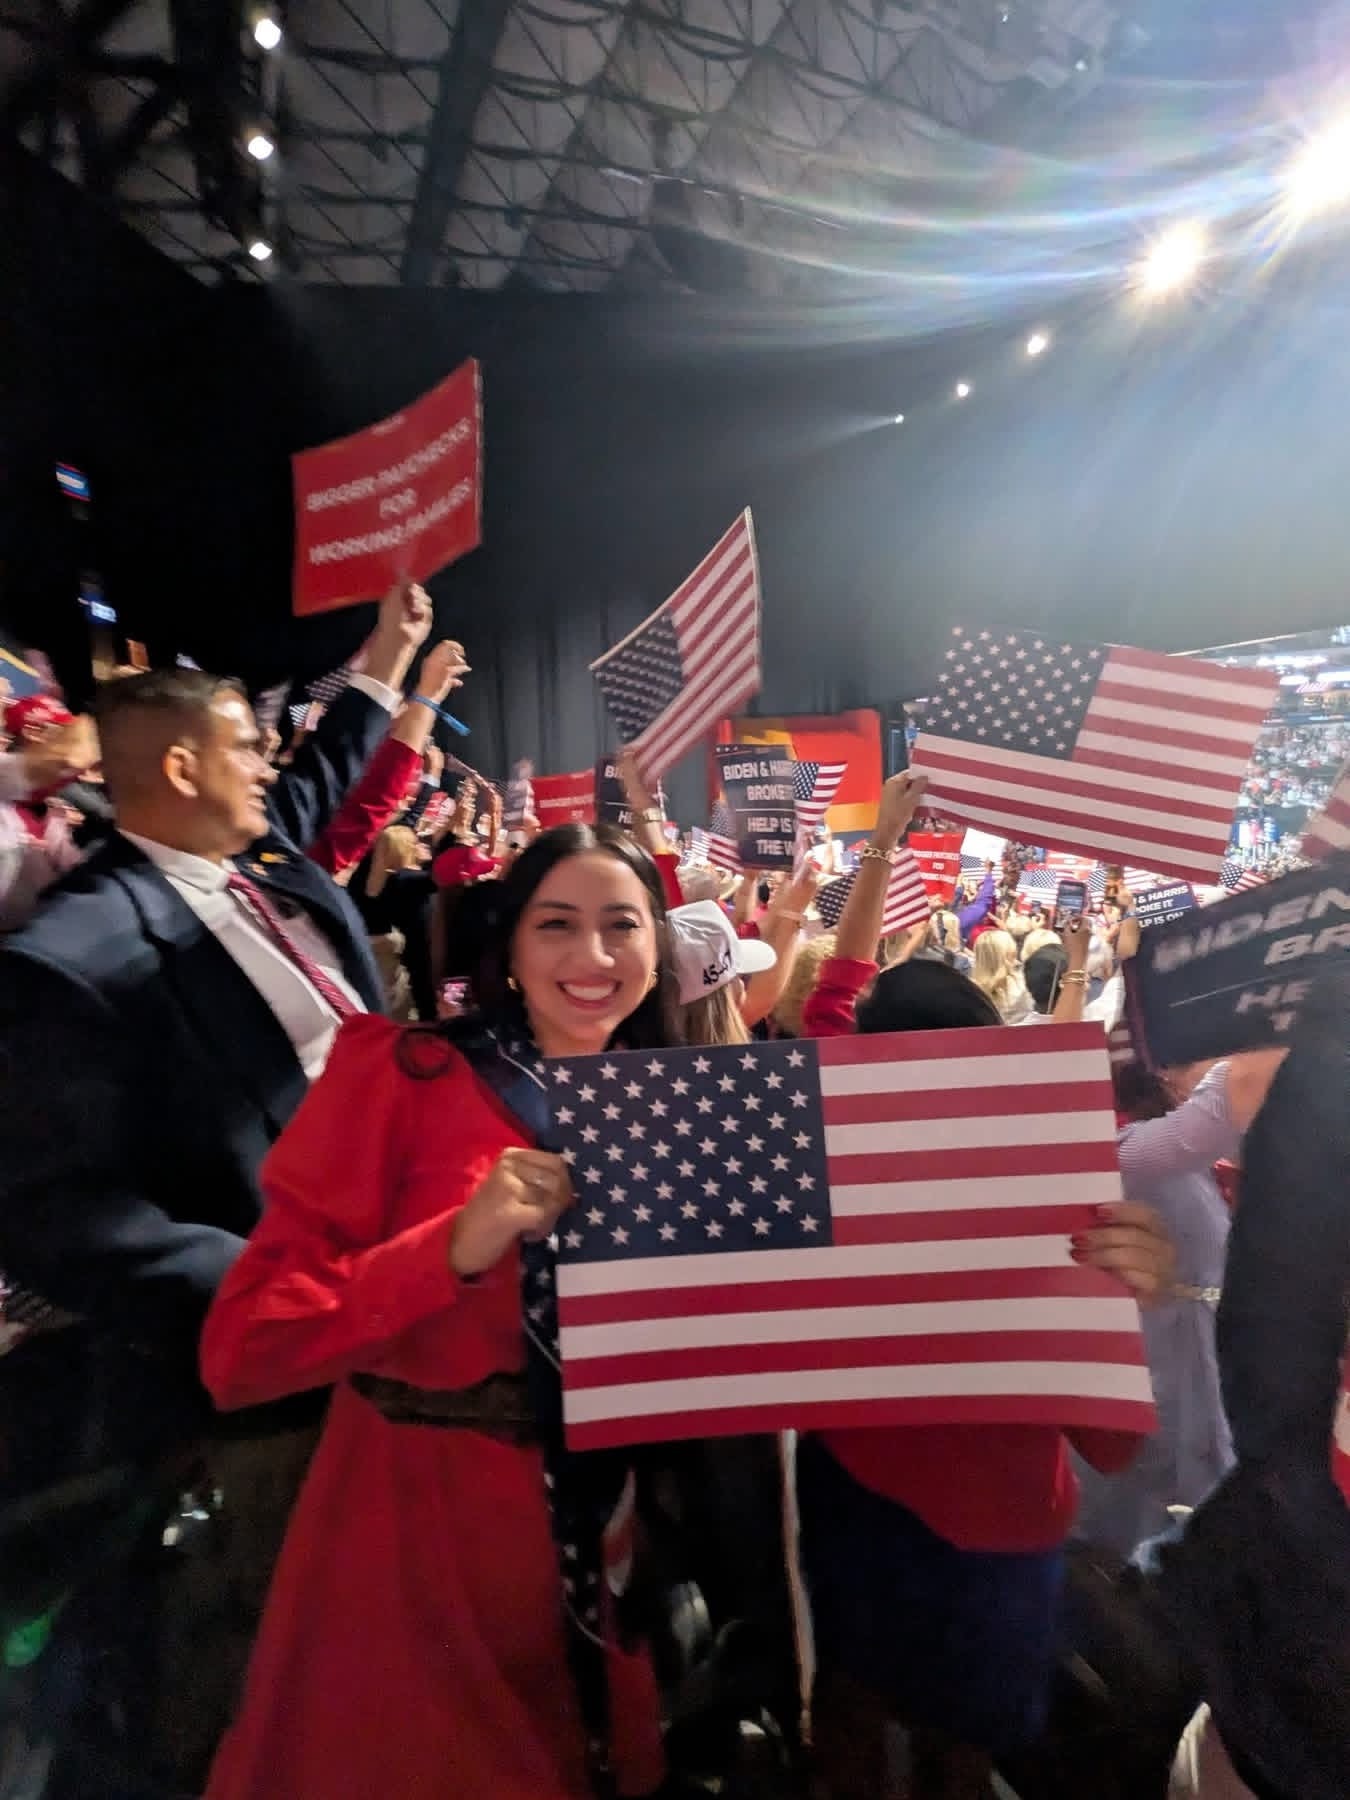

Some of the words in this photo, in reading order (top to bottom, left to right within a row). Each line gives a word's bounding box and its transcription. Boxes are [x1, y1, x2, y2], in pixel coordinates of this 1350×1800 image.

[723, 762, 758, 781] BIDEN
[760, 760, 769, 777] &
[746, 784, 785, 801] BROKE
[747, 817, 777, 833] HELP
[780, 817, 793, 833] IS
[756, 839, 784, 855] THE
[1147, 884, 1189, 902] HARRIS
[1162, 898, 1174, 908] IT
[1138, 918, 1153, 928] LP
[1154, 915, 1166, 925] IS
